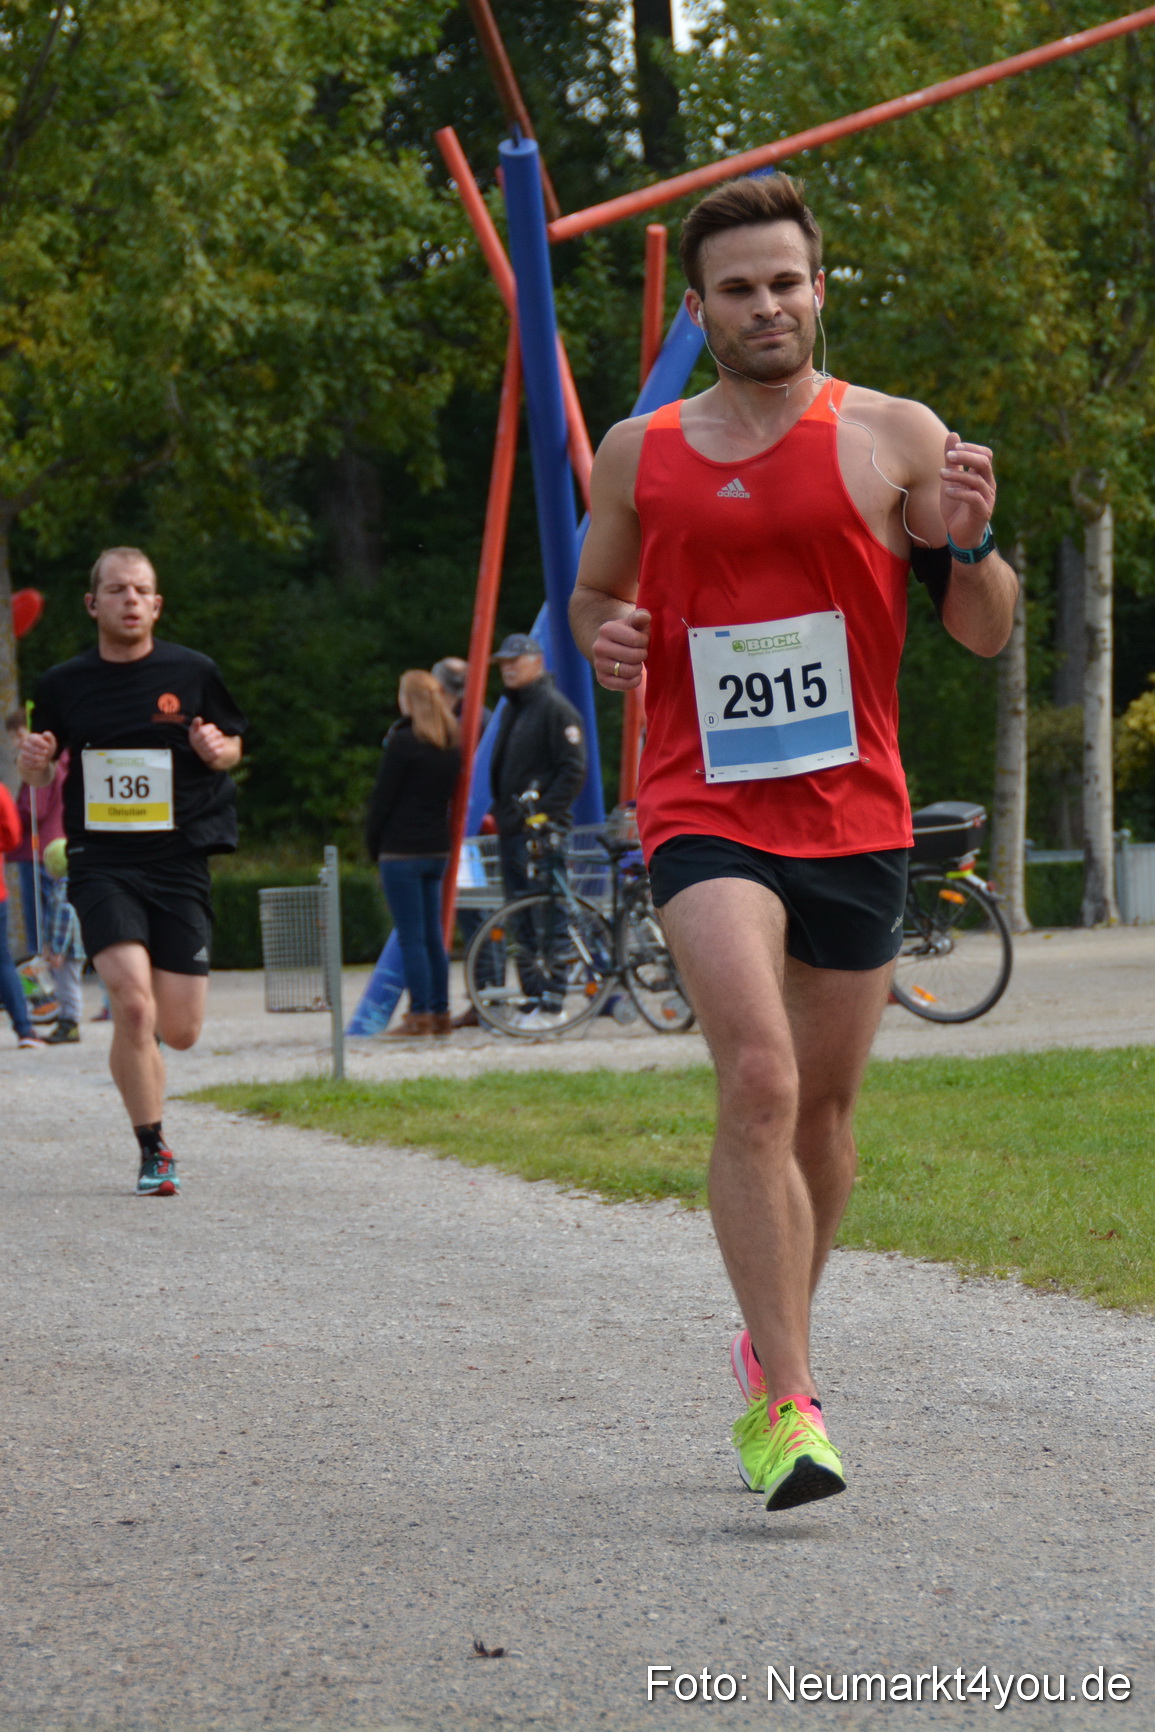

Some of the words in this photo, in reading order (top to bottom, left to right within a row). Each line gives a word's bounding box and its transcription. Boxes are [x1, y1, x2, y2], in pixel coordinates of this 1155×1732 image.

[717, 490, 750, 499] adidas
[745, 632, 801, 651] BOCK
[719, 662, 827, 720] 2915
[708, 715, 715, 725] D
[104, 775, 150, 799] 136
[779, 1402, 792, 1415] NIKE
